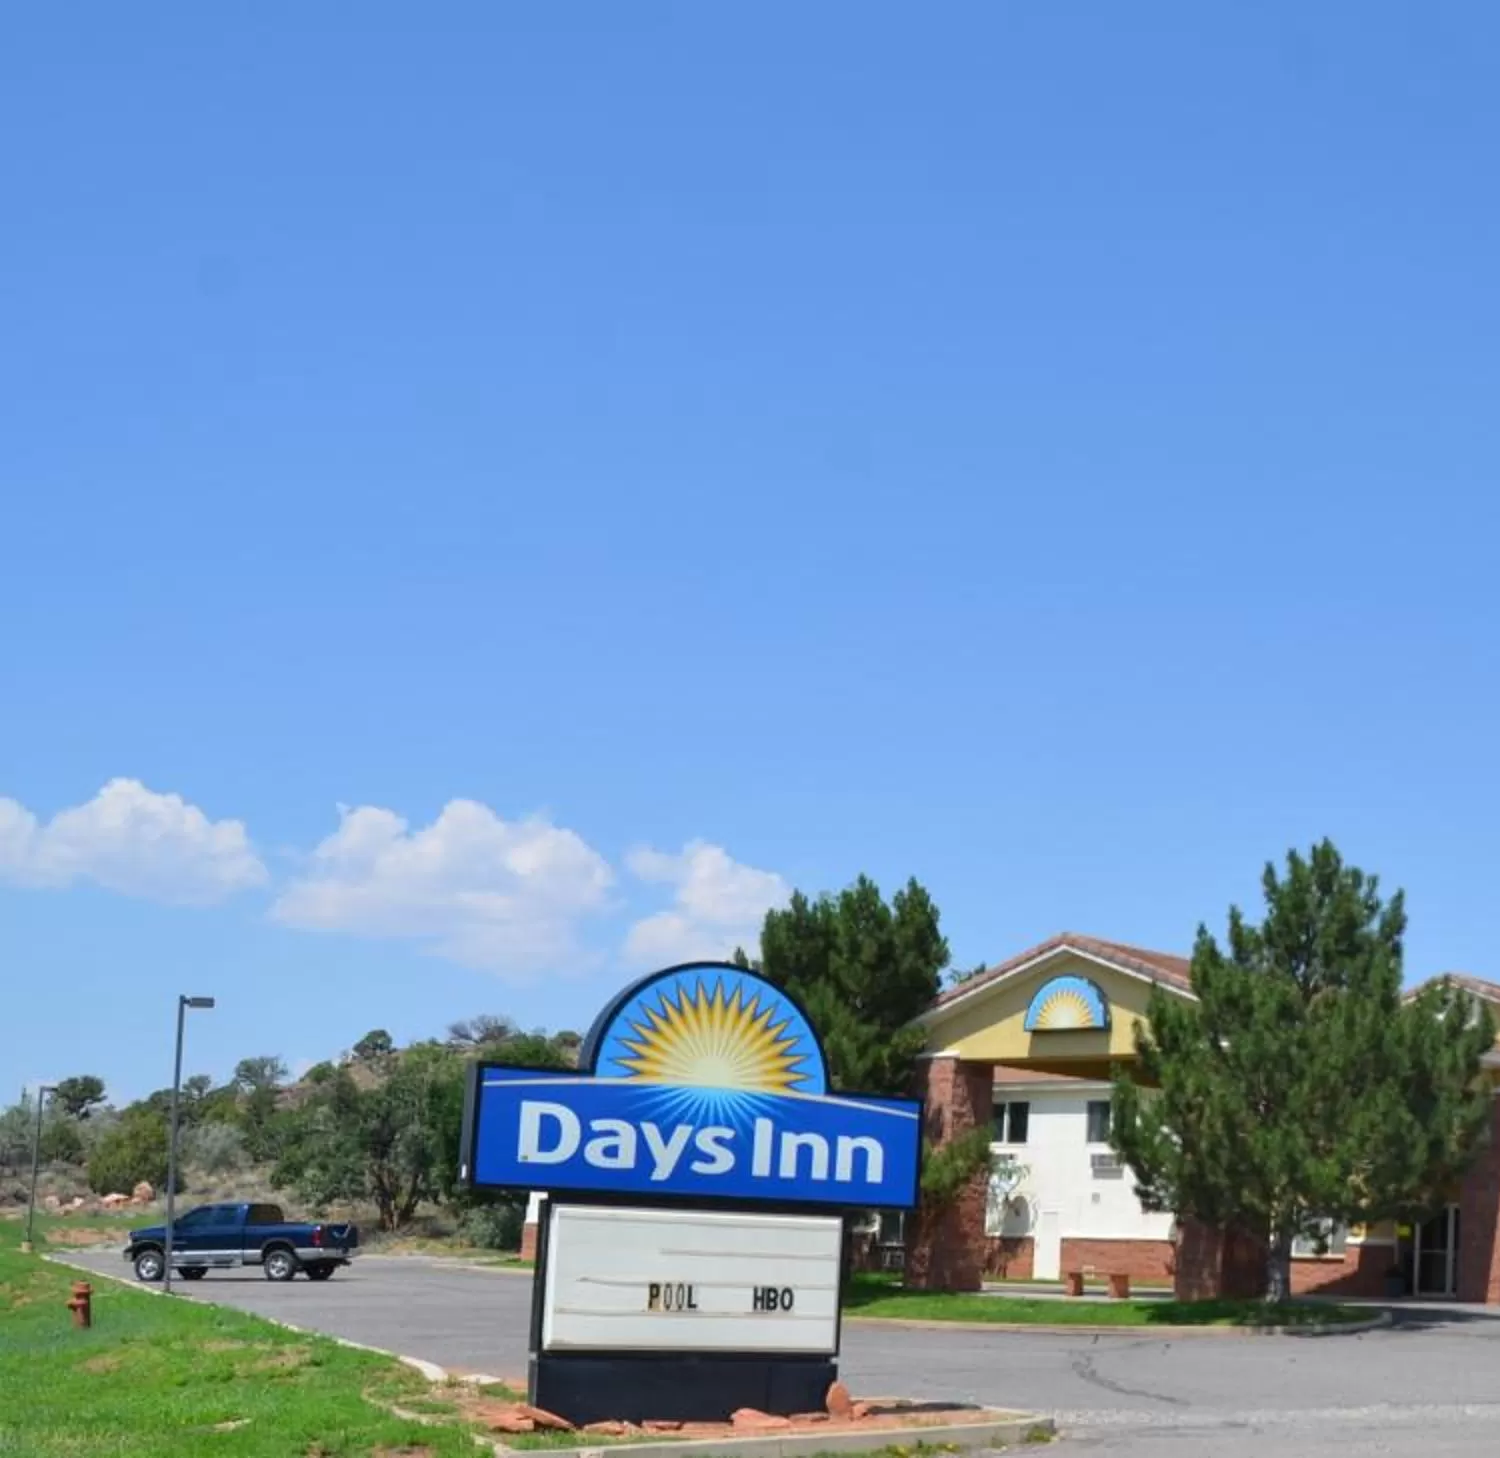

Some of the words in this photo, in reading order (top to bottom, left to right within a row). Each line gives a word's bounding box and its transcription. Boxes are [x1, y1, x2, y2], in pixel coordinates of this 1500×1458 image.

[518, 1100, 736, 1181] Days
[752, 1117, 884, 1184] Inn
[648, 1283, 698, 1311] POOL
[753, 1286, 794, 1312] HBO
